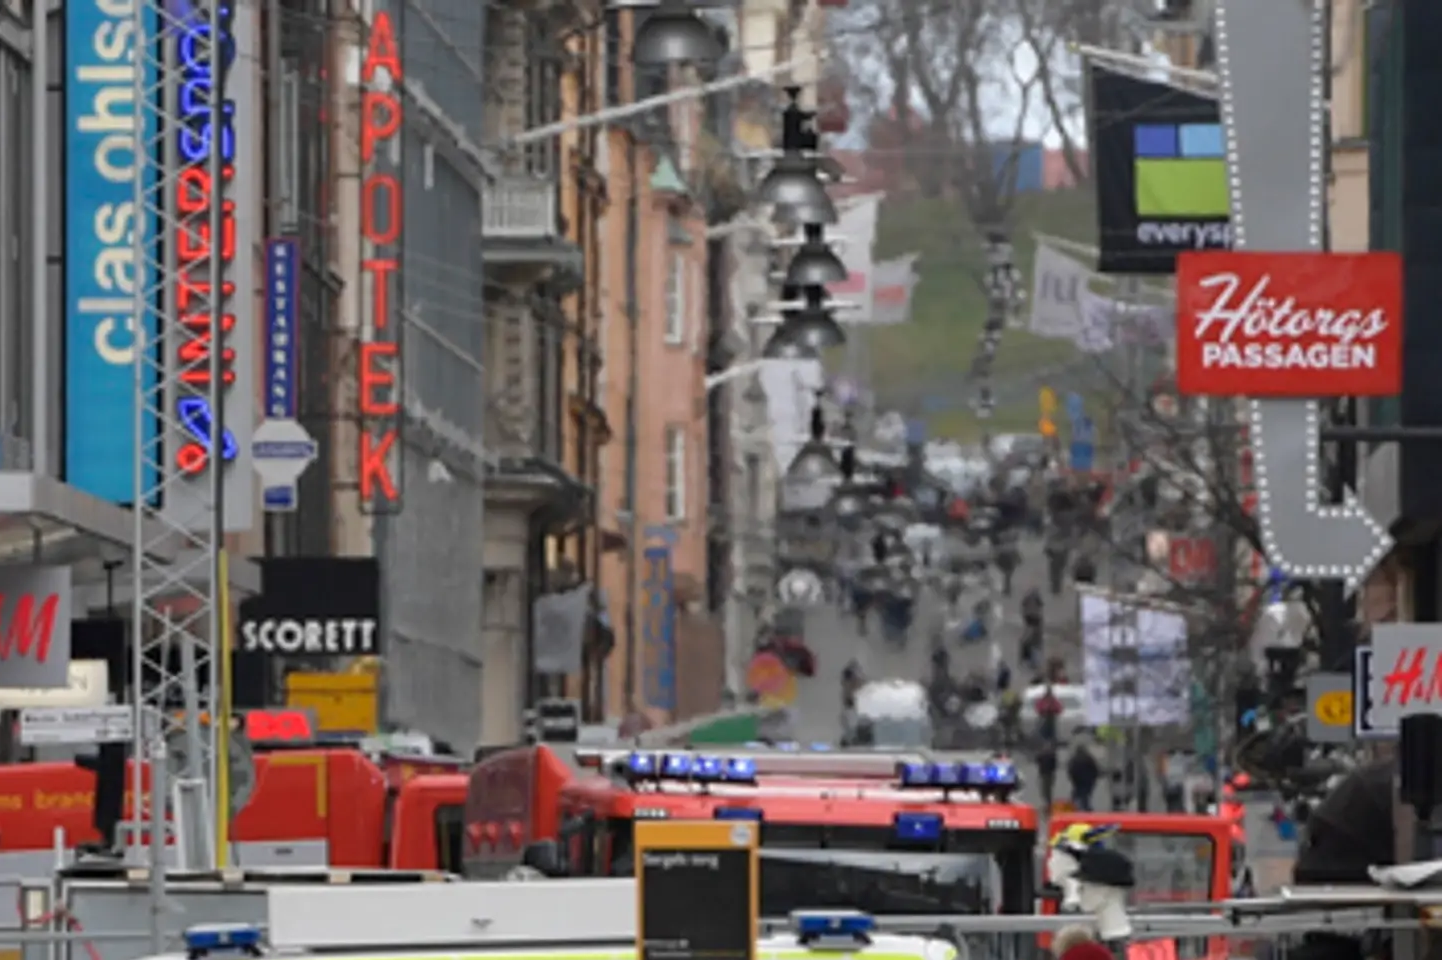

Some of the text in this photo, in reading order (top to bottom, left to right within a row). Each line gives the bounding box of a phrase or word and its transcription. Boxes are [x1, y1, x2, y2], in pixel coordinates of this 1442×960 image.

[175, 4, 237, 385] INTERSPO
[77, 200, 146, 365] clas
[361, 11, 402, 501] APOTEK
[1194, 271, 1390, 344] Hötorgs
[1202, 343, 1376, 368] PASSAGEN
[241, 617, 376, 651] SCORETT
